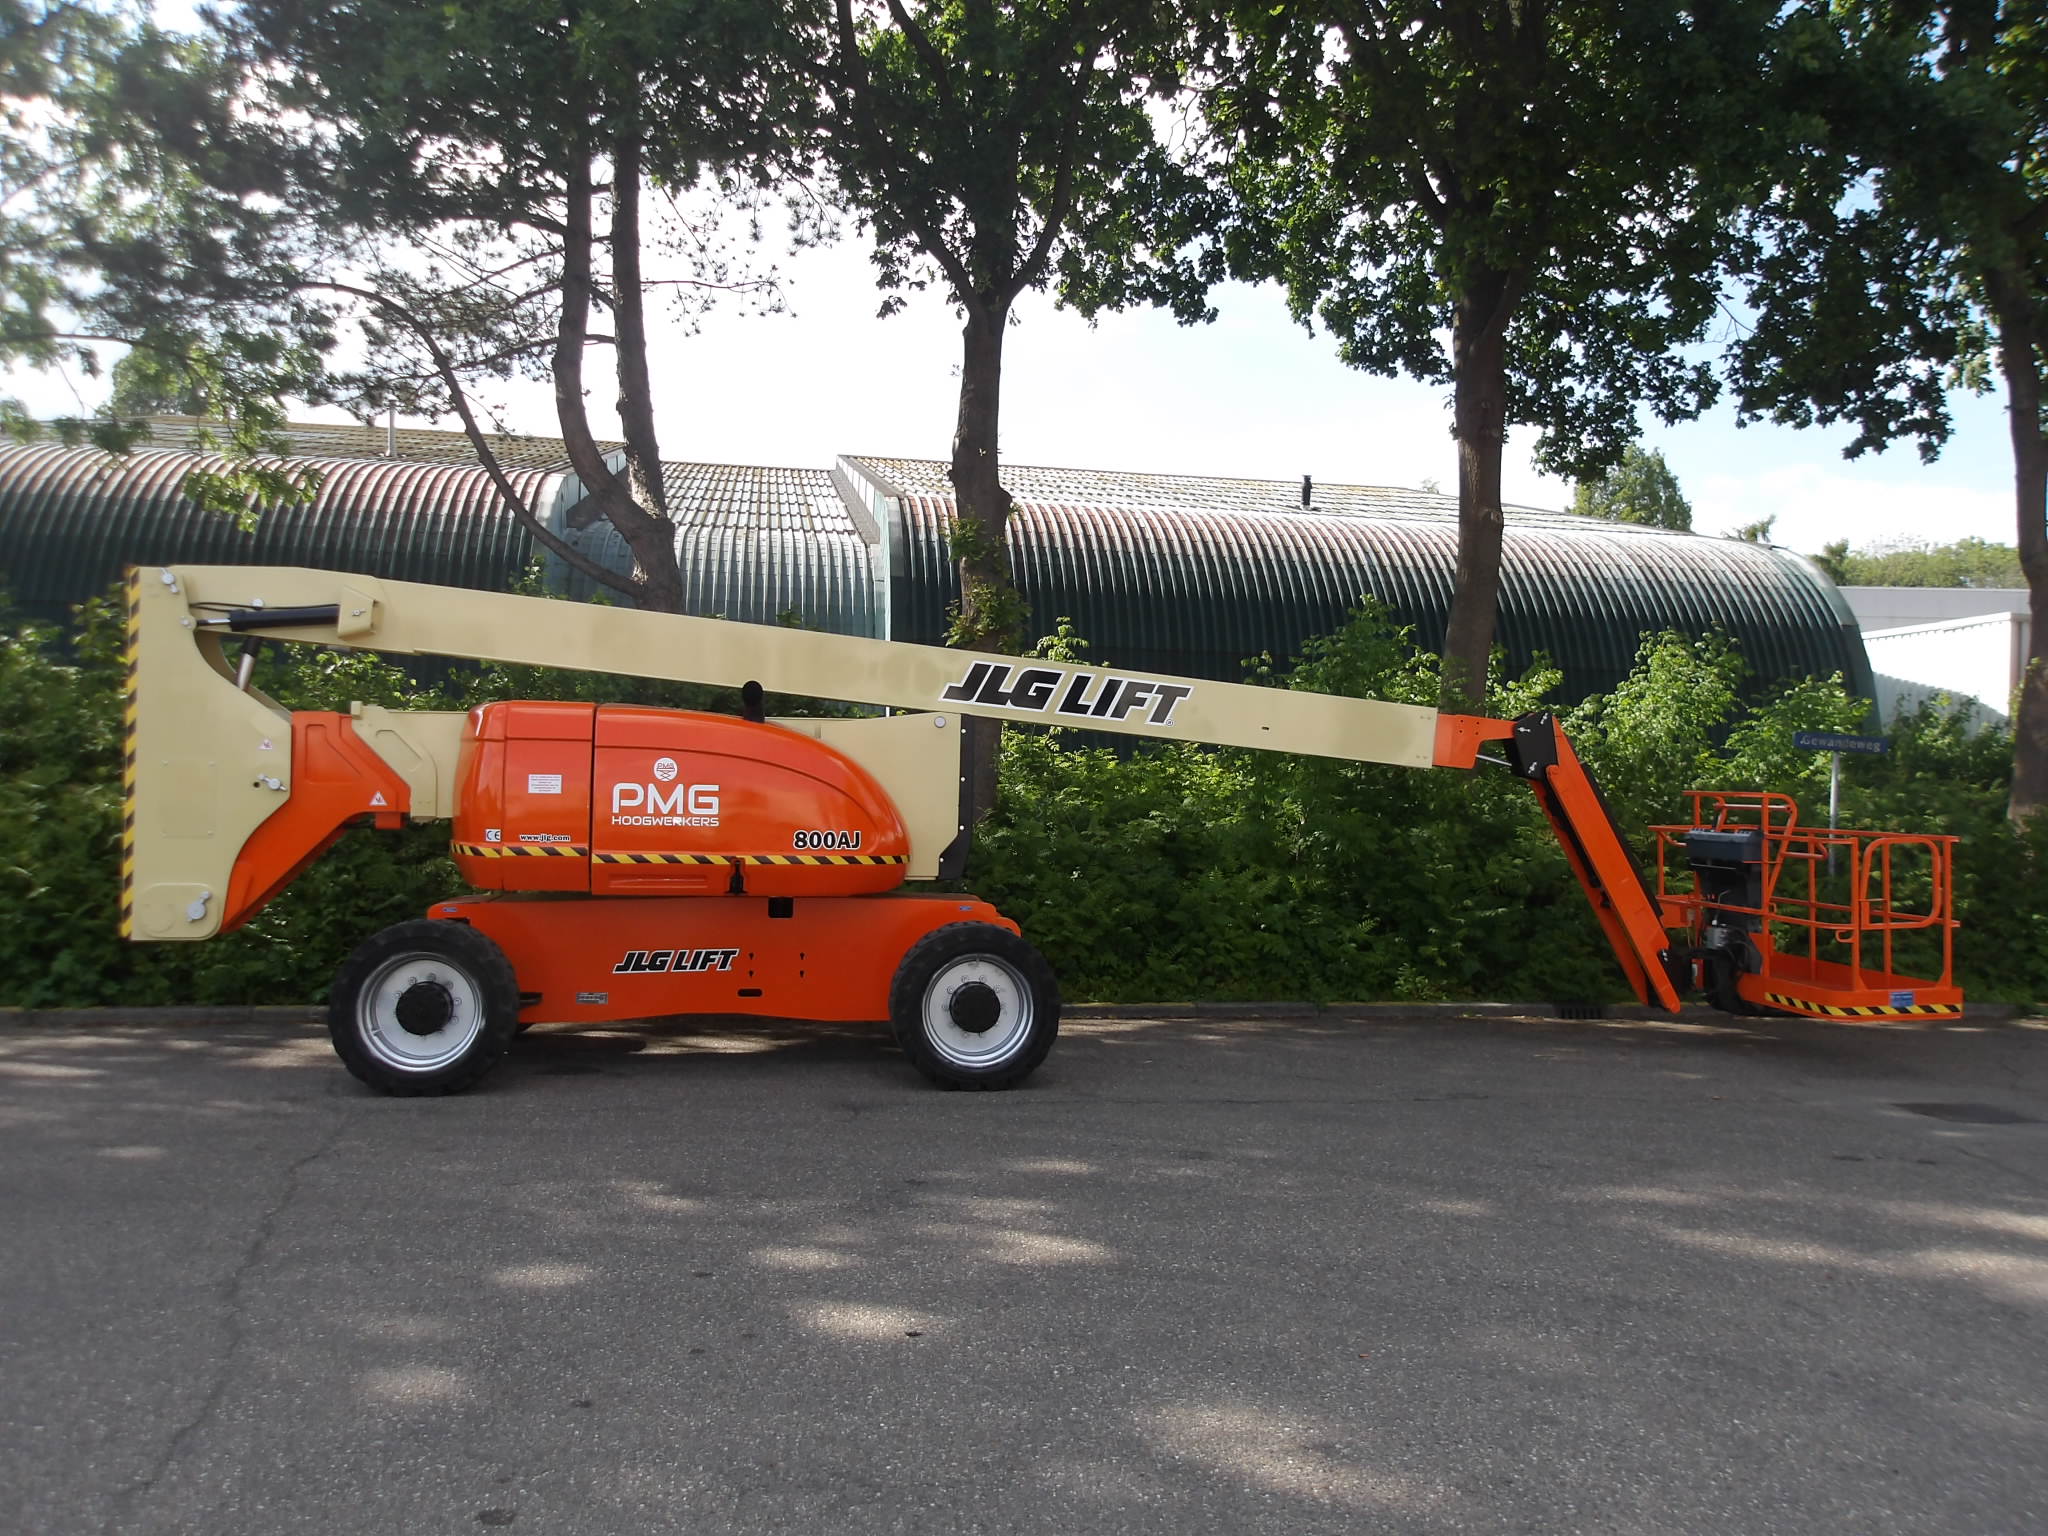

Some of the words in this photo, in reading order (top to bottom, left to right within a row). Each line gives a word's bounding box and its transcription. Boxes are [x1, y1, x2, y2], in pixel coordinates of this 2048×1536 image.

[940, 661, 1064, 711] JLG
[1057, 674, 1193, 725] LIFT
[612, 783, 719, 815] PMG
[612, 815, 719, 827] HOOGWERKERS
[520, 834, 570, 842] www.jlg.com
[794, 830, 861, 849] 800AJ
[613, 951, 674, 973] JLG
[671, 949, 739, 972] LIFT
